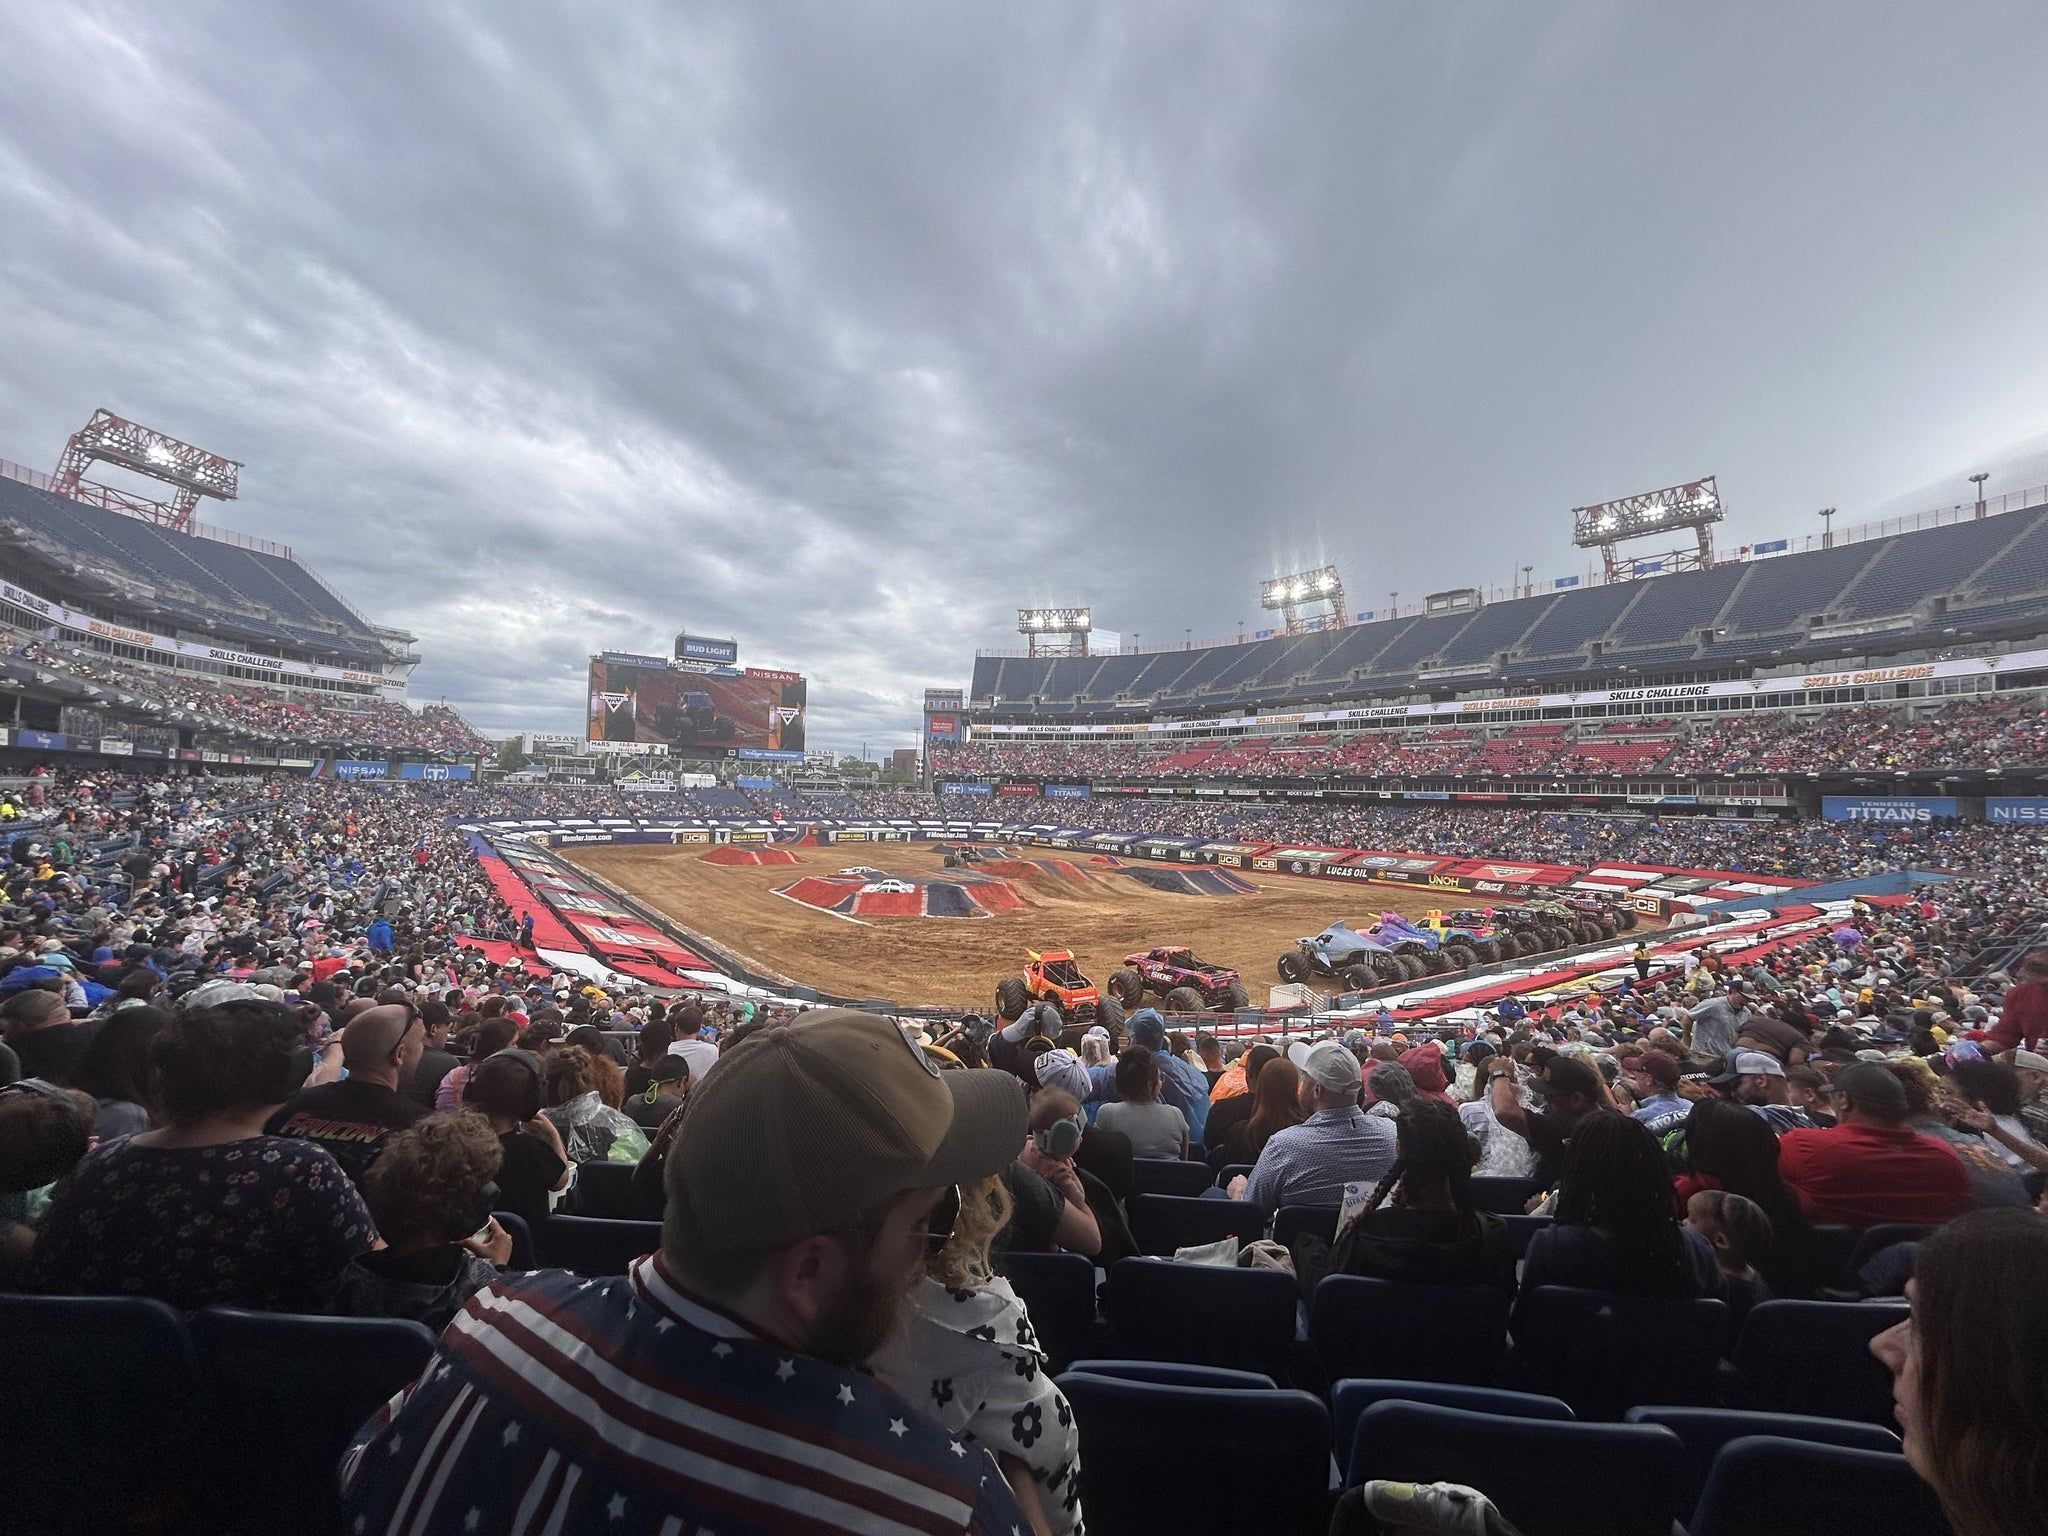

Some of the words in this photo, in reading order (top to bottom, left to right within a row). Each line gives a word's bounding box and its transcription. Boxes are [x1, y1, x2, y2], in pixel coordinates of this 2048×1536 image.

[686, 644, 705, 653] BUD
[706, 646, 732, 656] LIGHT
[208, 649, 236, 662] SKILLS
[237, 654, 284, 670] CHALLENGE
[342, 672, 368, 682] SKILLS
[752, 670, 794, 681] NISSAN
[1802, 673, 1849, 688] SKILLS
[1852, 665, 1936, 684] CHALLENGE
[1609, 689, 1645, 702] SKILLS
[1646, 685, 1710, 700] CHALLENGE
[1462, 701, 1490, 711] SKILLS
[1491, 698, 1540, 710] CHALLENGE
[1348, 708, 1369, 718] SKILLS
[1370, 706, 1408, 717] CHALLENGE
[1256, 716, 1274, 724] SKILLS
[1275, 714, 1306, 724] CHALLENGE
[339, 766, 384, 776] NISSAN
[1846, 807, 1931, 820] TITANS
[1994, 806, 2048, 818] NISS
[562, 834, 612, 842] MonsterJam.com
[1096, 842, 1110, 851] LUCAS
[1151, 847, 1167, 855] BKT
[1180, 850, 1196, 858] BKT
[1220, 856, 1239, 864] JCB
[1255, 860, 1275, 869] JCB
[1326, 866, 1352, 877] LUCAS
[1354, 868, 1368, 878] OIL
[1428, 874, 1460, 886] UNOH
[1151, 972, 1173, 982] SIDE
